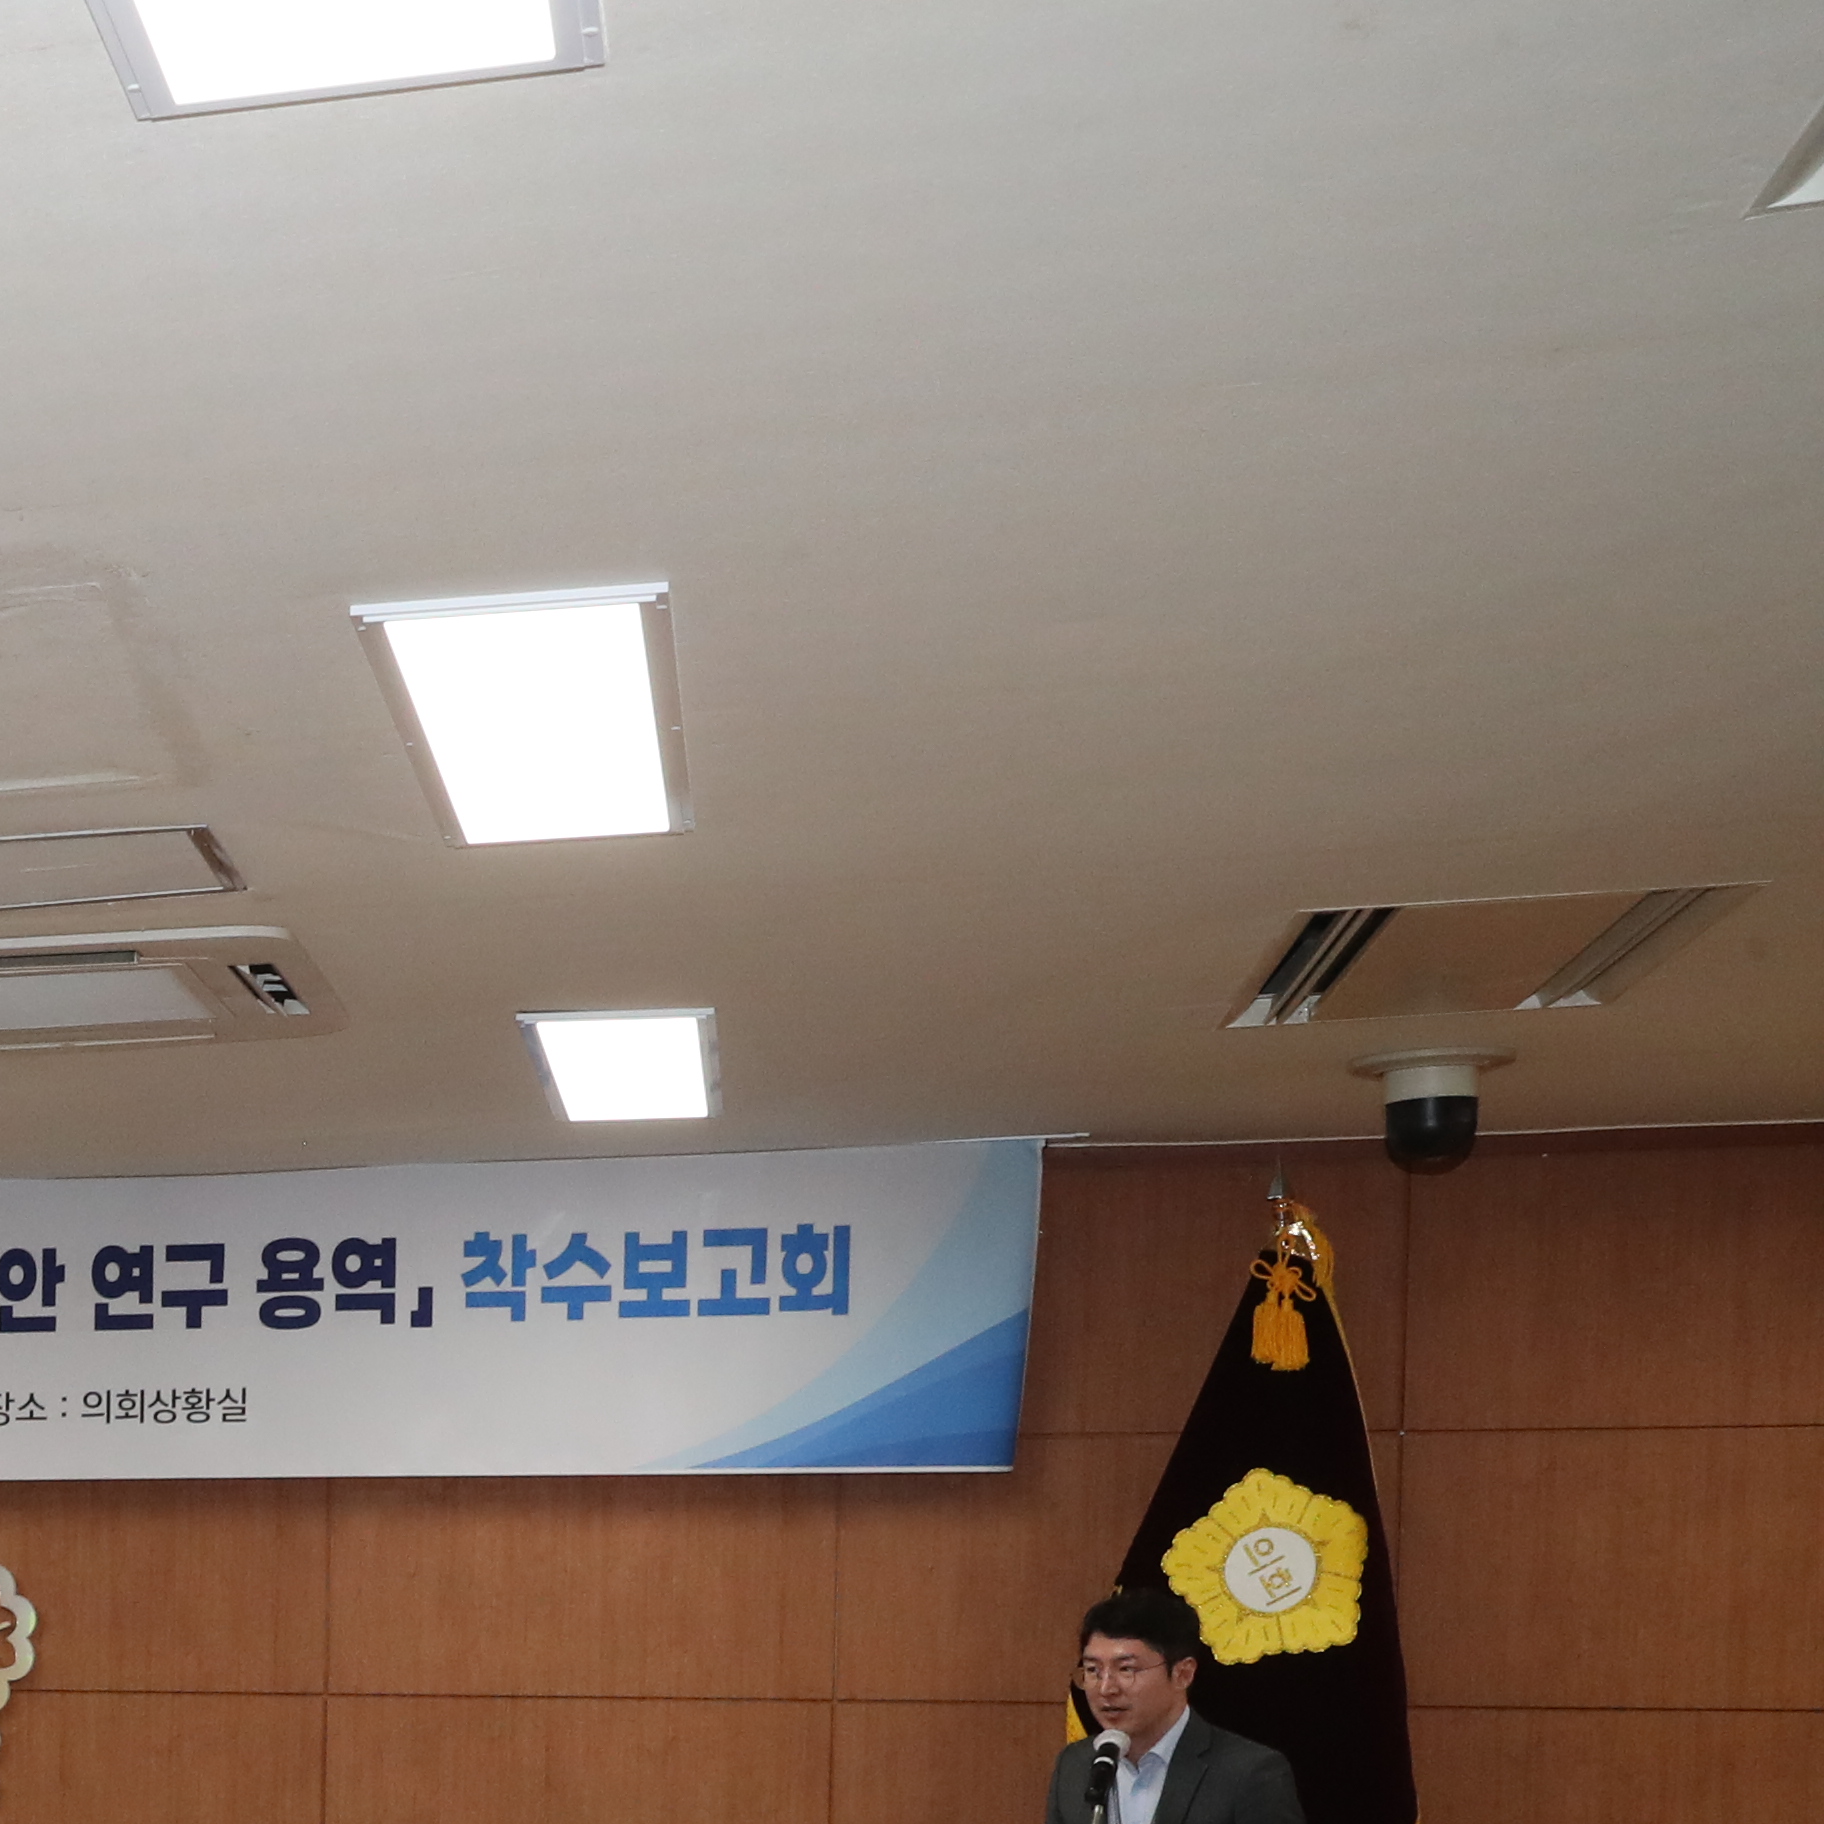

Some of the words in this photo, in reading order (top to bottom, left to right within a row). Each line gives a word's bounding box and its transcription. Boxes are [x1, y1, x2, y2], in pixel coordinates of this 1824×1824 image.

[91, 1242, 229, 1332] 연구
[256, 1237, 434, 1331] 용역」
[461, 1223, 851, 1322] 착수보고회
[80, 1386, 247, 1425] 의회상황실
[1242, 1537, 1303, 1606] 의회
